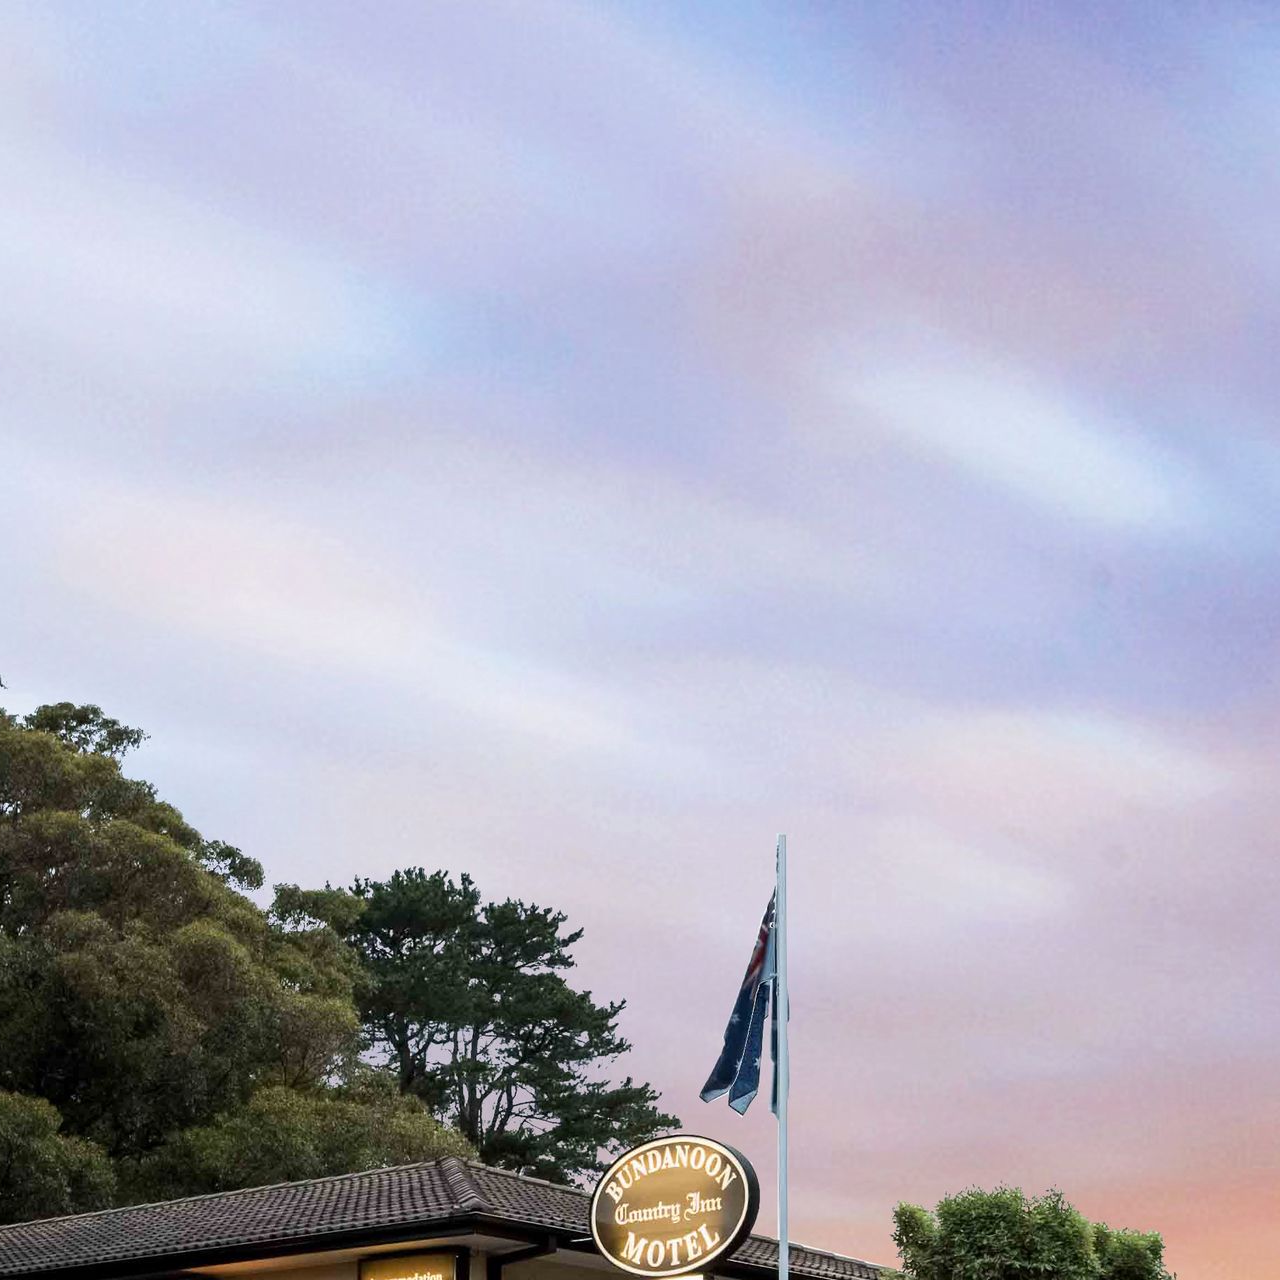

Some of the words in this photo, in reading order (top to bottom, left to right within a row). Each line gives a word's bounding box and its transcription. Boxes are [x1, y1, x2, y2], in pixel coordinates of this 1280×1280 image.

[605, 1145, 737, 1204] BUNDANOON
[615, 1202, 680, 1225] Country
[684, 1191, 722, 1220] Inn
[620, 1223, 720, 1267] MOTEL
